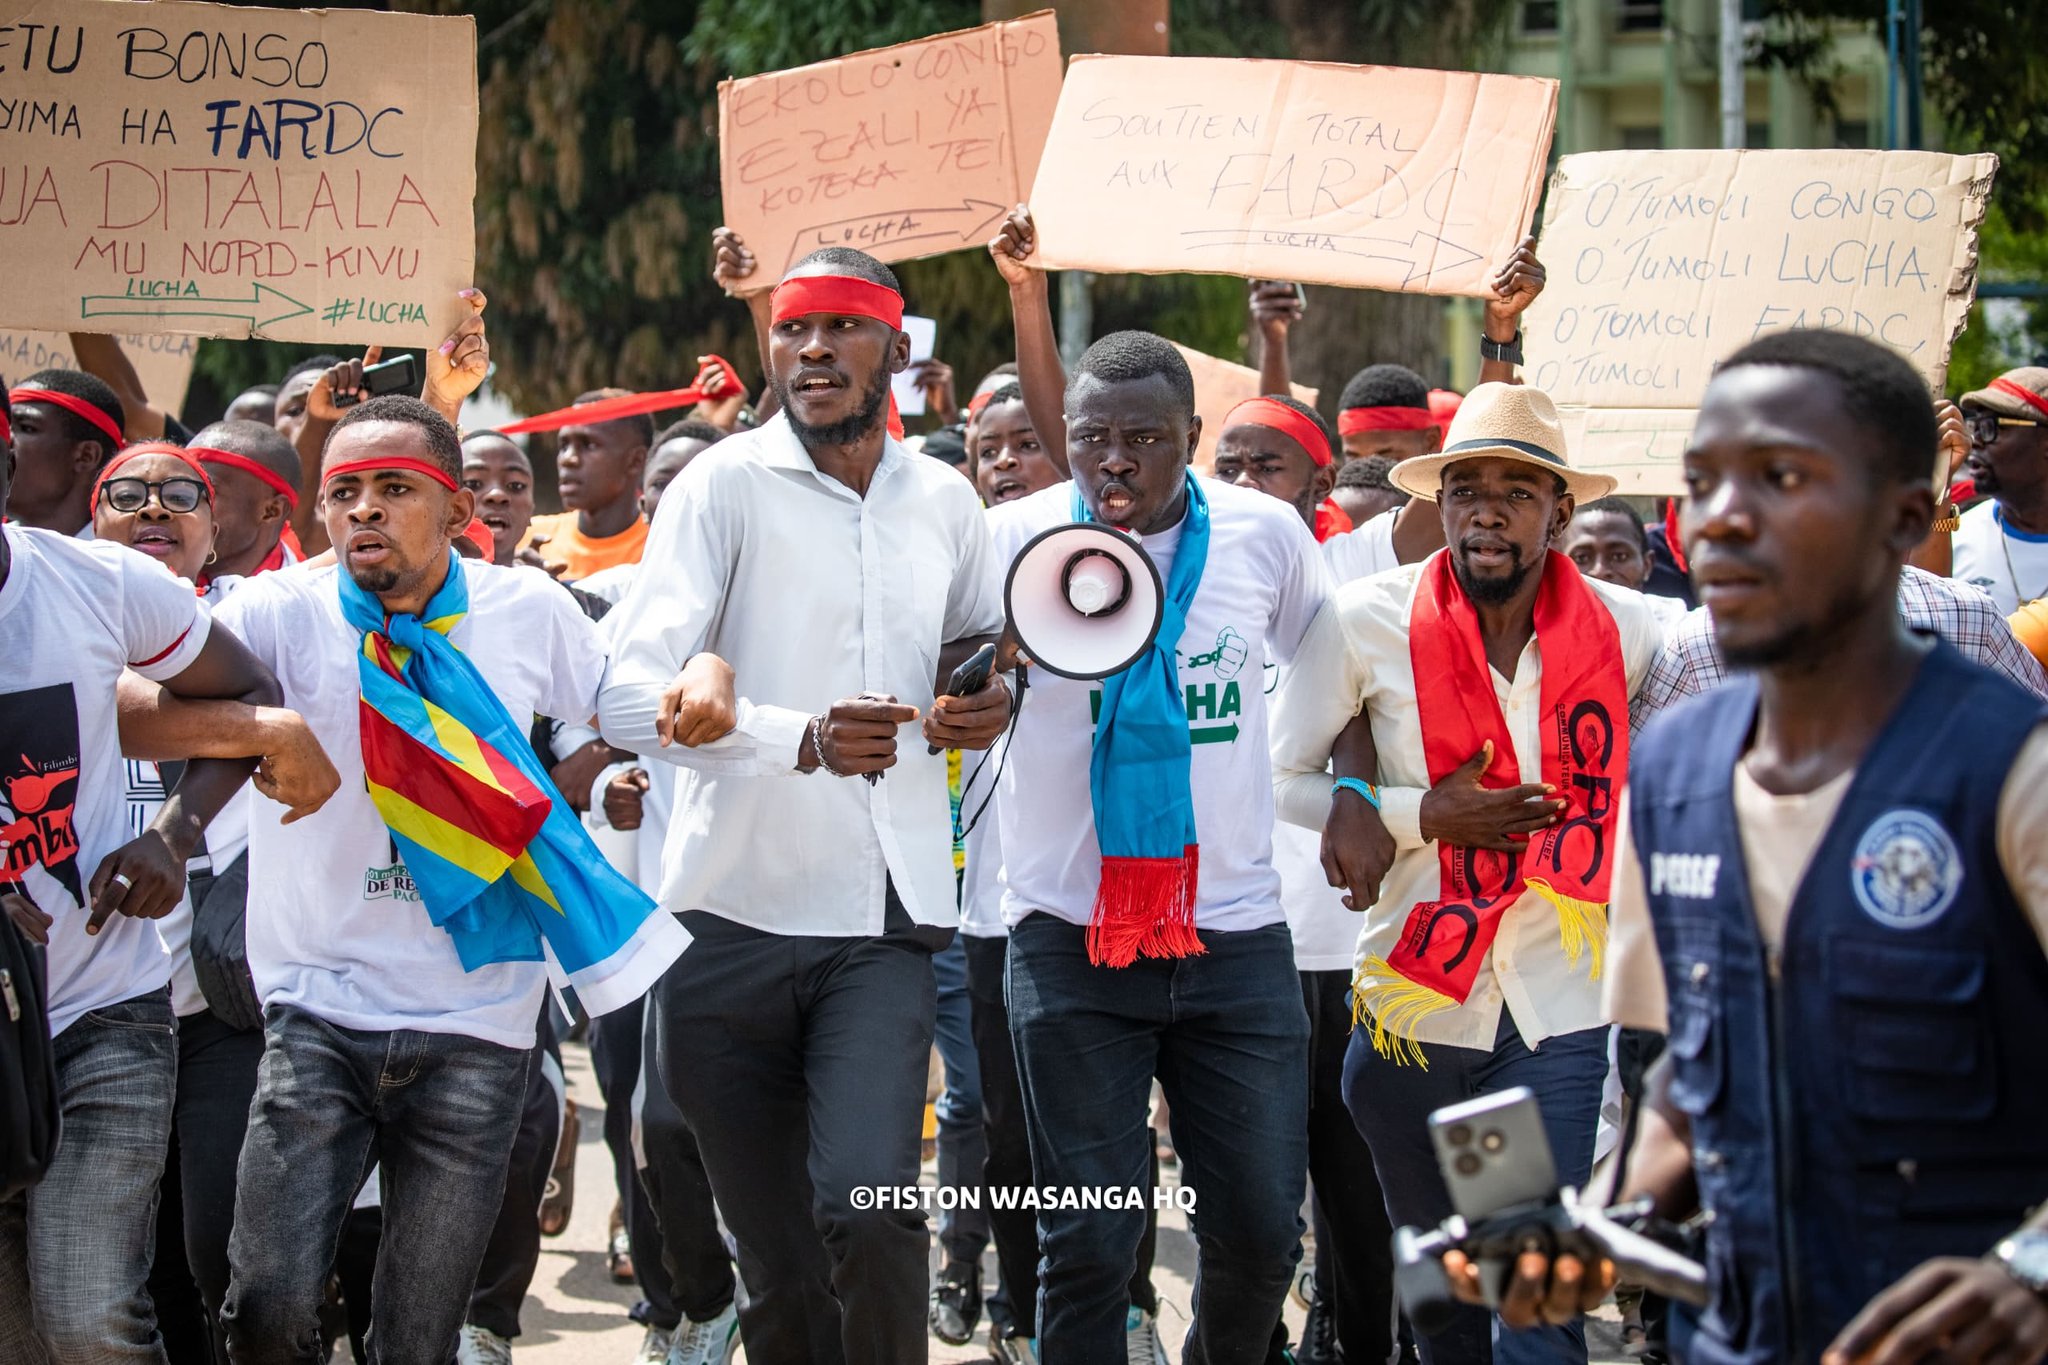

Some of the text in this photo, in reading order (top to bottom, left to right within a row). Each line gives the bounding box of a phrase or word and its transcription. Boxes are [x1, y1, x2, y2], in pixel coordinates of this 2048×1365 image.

[117, 27, 329, 89] BONSO
[733, 30, 1046, 128] EKOLO CONGO
[121, 107, 177, 146] HA
[205, 98, 405, 161] FARDC
[944, 87, 998, 134] YA
[1081, 97, 1418, 154] SOUTIEN TOTAL
[89, 158, 440, 233] DITALALA
[758, 160, 908, 218] KOTEKA
[1106, 151, 1474, 228] AUX FARDC
[1790, 179, 1938, 222] CONGO
[817, 214, 921, 246] LUCHA
[1263, 232, 1337, 253] LUCHA
[74, 236, 420, 280] MU NORD-KIVU
[125, 277, 201, 299] LUCHA
[322, 297, 430, 328] #LUCHA
[43, 754, 78, 771] Filimbi
[1558, 703, 1570, 790] COMMUNICATEUR
[367, 877, 418, 893] DE RE
